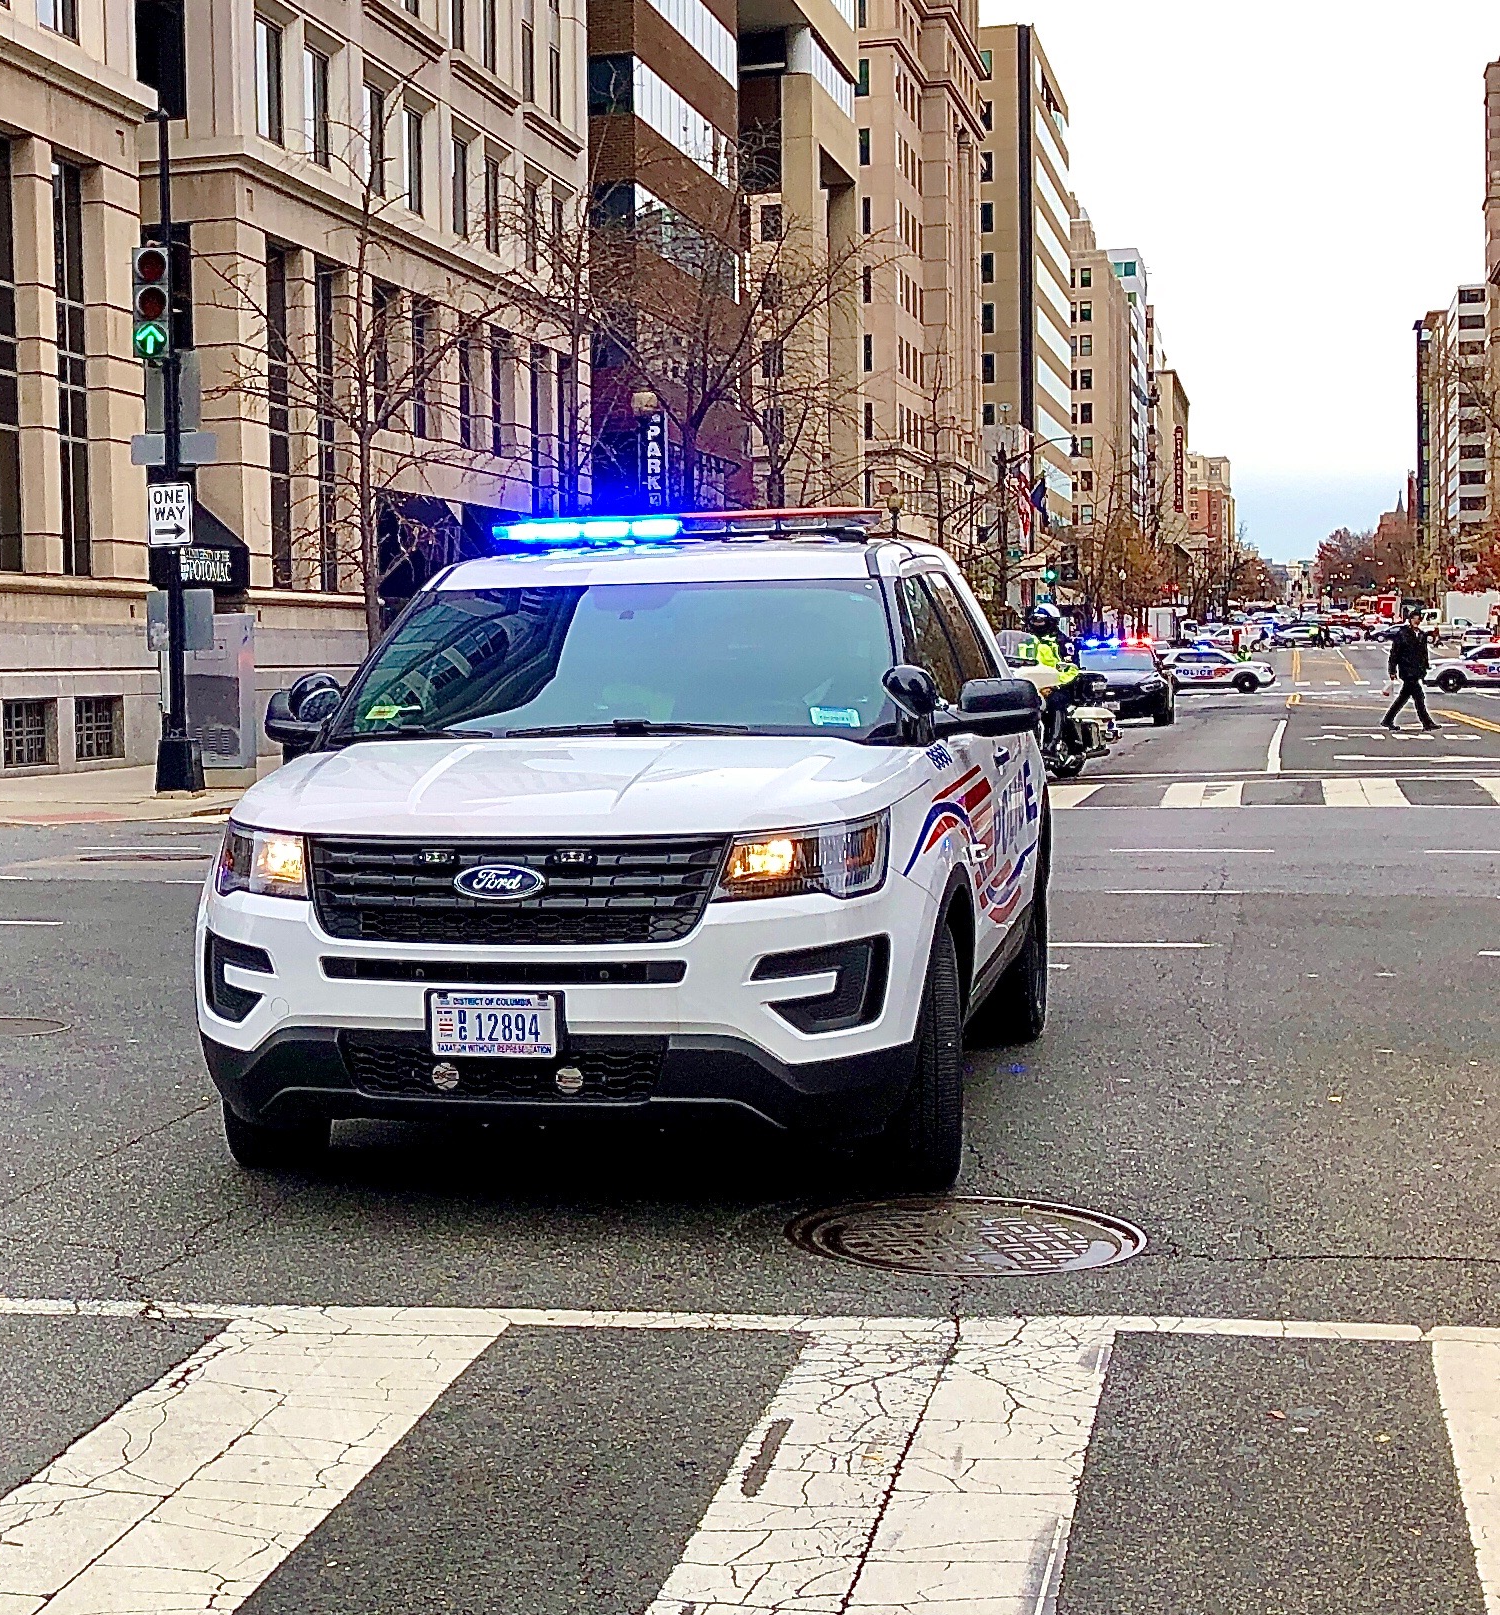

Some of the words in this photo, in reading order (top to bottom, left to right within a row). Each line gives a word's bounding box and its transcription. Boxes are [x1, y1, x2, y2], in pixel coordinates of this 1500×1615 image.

[647, 426, 661, 490] PARK
[153, 489, 184, 504] ONE
[154, 506, 186, 521] WAY
[187, 560, 232, 581] POTOMAC
[1175, 668, 1214, 676] POLICE
[472, 869, 522, 889] Ford
[453, 997, 484, 1005] DISTRICT
[485, 998, 494, 1006] OF
[496, 998, 532, 1007] COLUMBIA
[475, 1012, 540, 1042] 12894
[468, 1044, 495, 1053] WITHOUT
